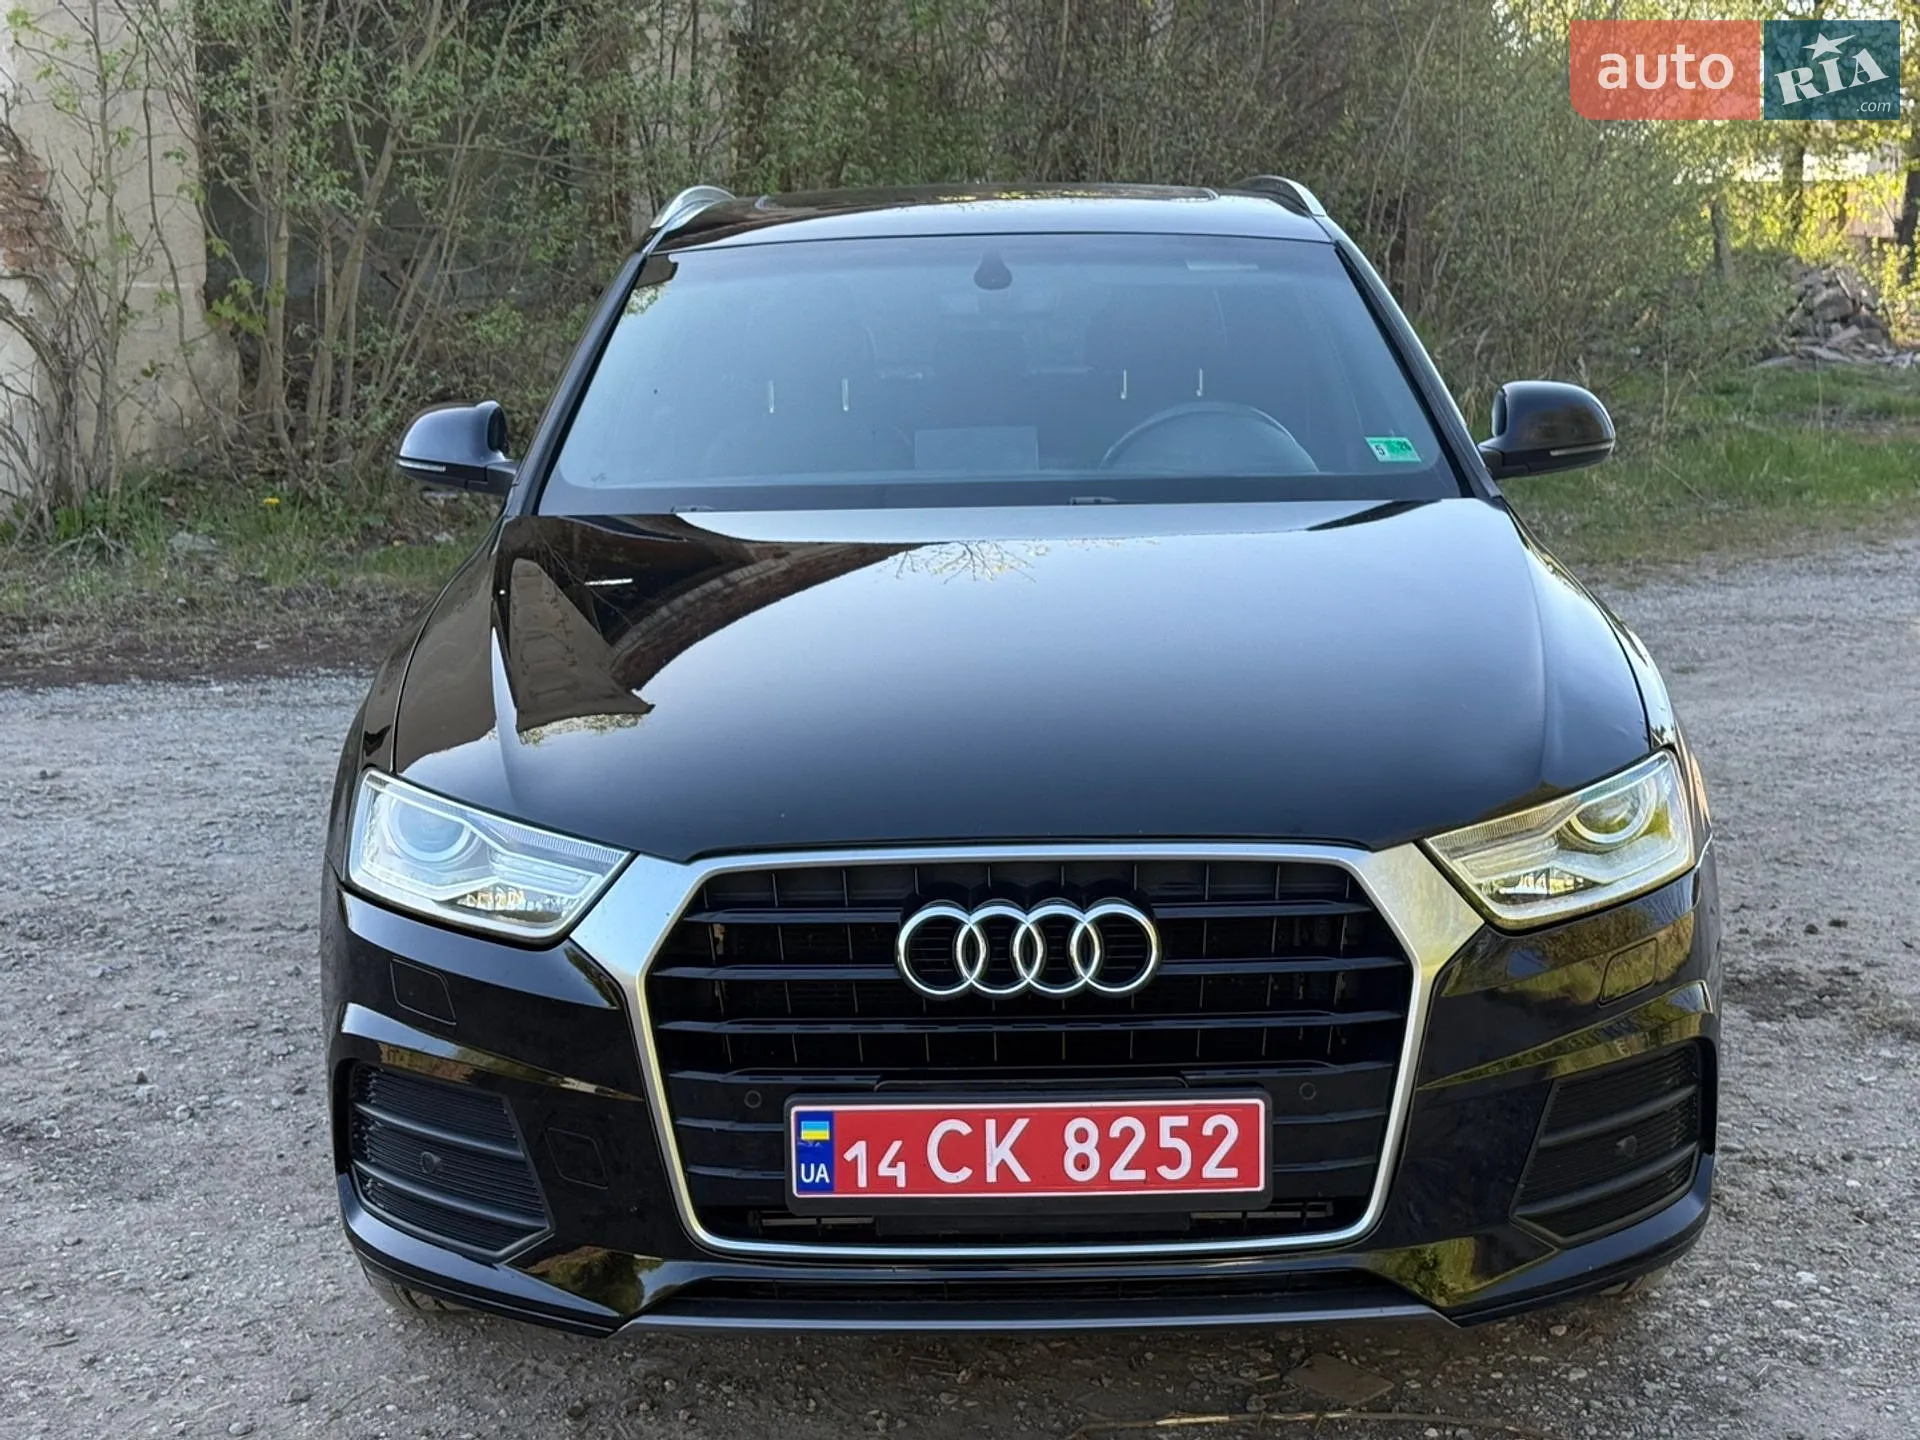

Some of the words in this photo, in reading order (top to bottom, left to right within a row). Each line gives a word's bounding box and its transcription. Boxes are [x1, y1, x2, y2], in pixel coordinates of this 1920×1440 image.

[801, 1162, 830, 1184] UA
[842, 1139, 906, 1188] 14
[927, 1118, 1031, 1184] CK
[1063, 1115, 1239, 1183] 8252
